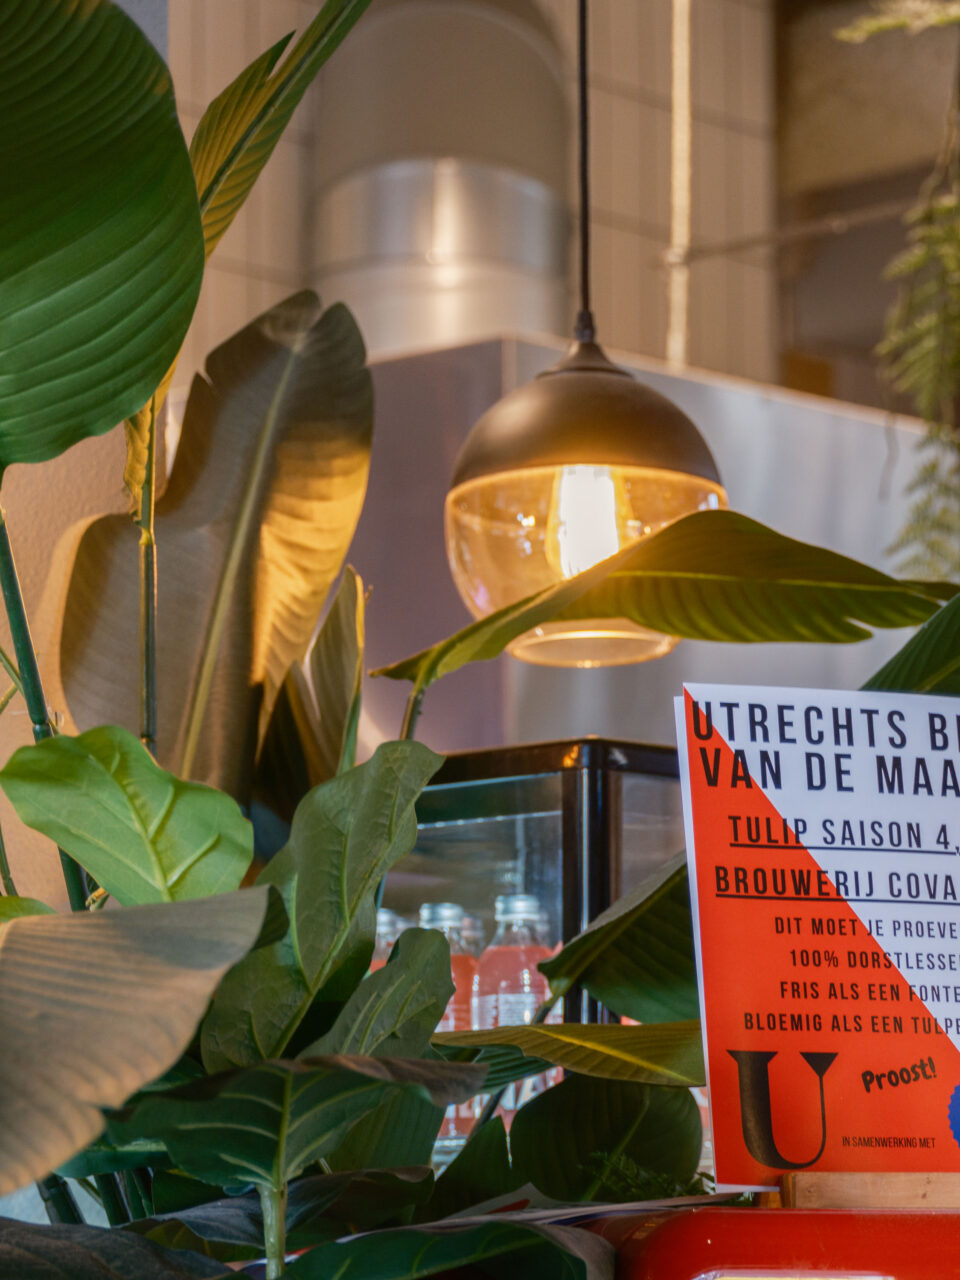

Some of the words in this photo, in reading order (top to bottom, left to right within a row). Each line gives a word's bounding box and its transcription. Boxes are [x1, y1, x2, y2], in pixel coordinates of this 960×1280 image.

[692, 700, 907, 748] UTRECHTS
[699, 747, 782, 790] VAN
[806, 752, 854, 793] DE
[728, 815, 807, 845] TULIP
[822, 820, 922, 849] SAISON
[715, 866, 874, 898] BROUWERIJ
[774, 917, 802, 935] DIT
[811, 918, 858, 936] MOET
[866, 919, 884, 937] JE
[789, 949, 839, 968] 100%
[780, 981, 819, 999] FRIS
[828, 982, 859, 1000] ALS
[868, 983, 900, 1002] EEN
[744, 1011, 822, 1032] BLOEMIG
[831, 1014, 862, 1033] ALS
[871, 1015, 903, 1034] EEN
[861, 1056, 938, 1093] Proost!
[842, 1136, 850, 1147] IN
[852, 1136, 919, 1149] SAMENWERKING
[920, 1137, 936, 1149] MET
